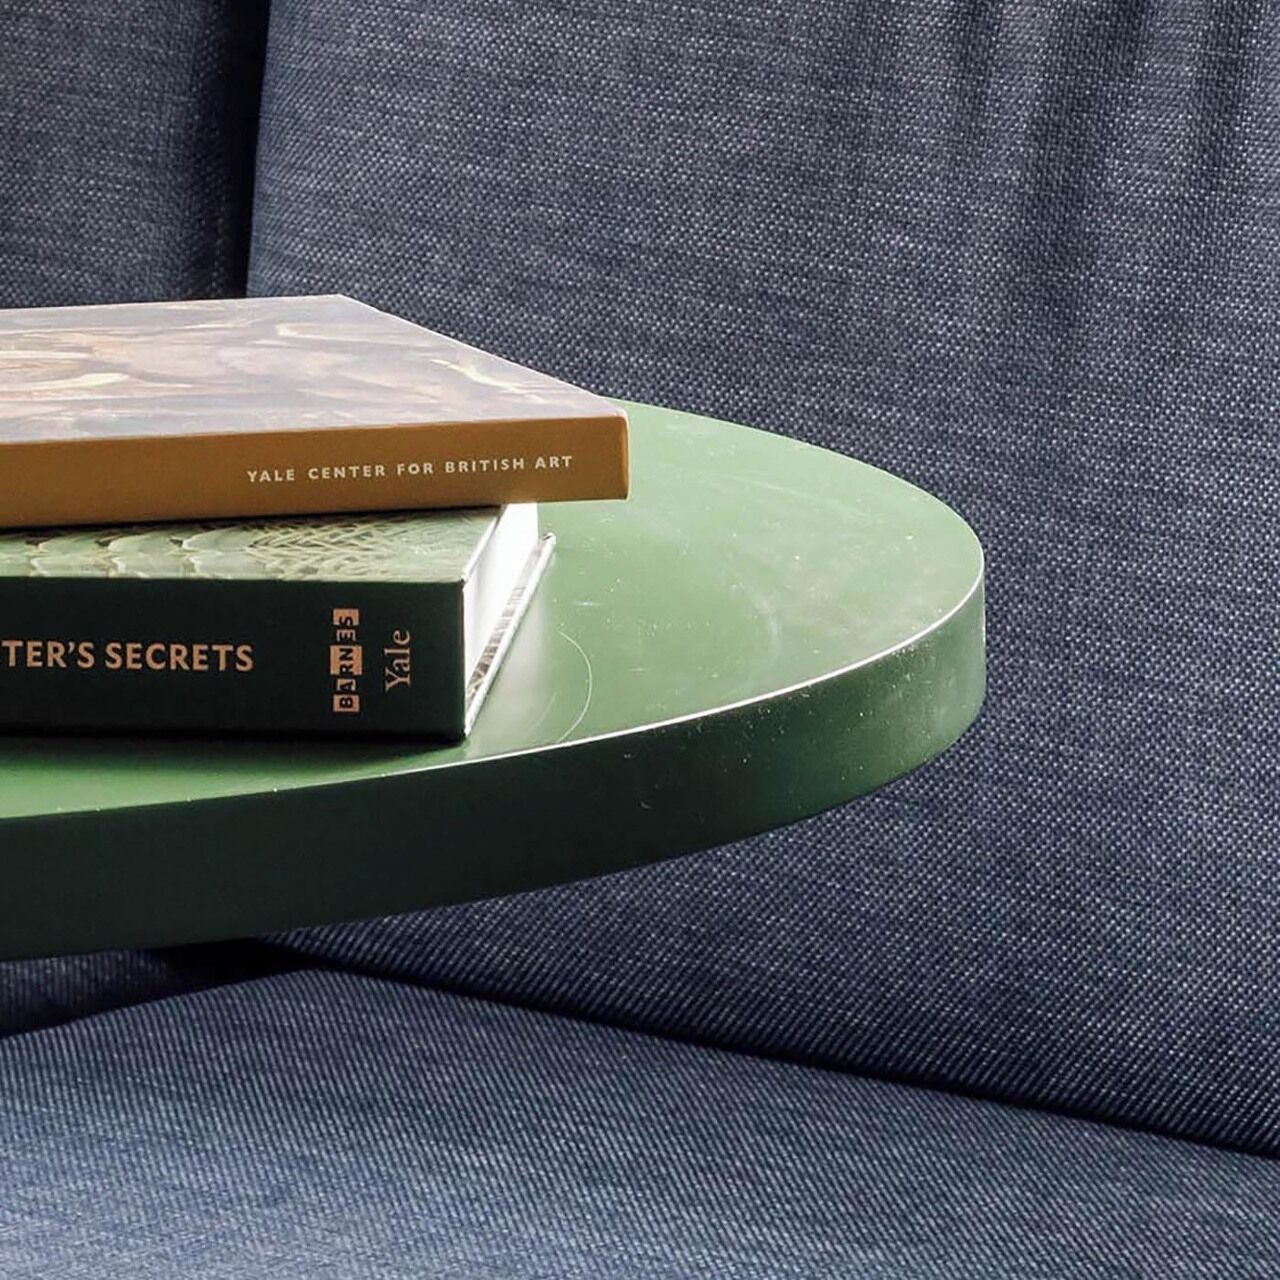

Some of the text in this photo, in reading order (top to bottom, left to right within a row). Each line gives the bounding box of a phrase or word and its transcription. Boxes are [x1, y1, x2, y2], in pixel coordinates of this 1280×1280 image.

[247, 454, 574, 483] YALE CENTER FOR BRITISH ART
[104, 641, 254, 672] SECRETS
[383, 630, 411, 692] Yale
